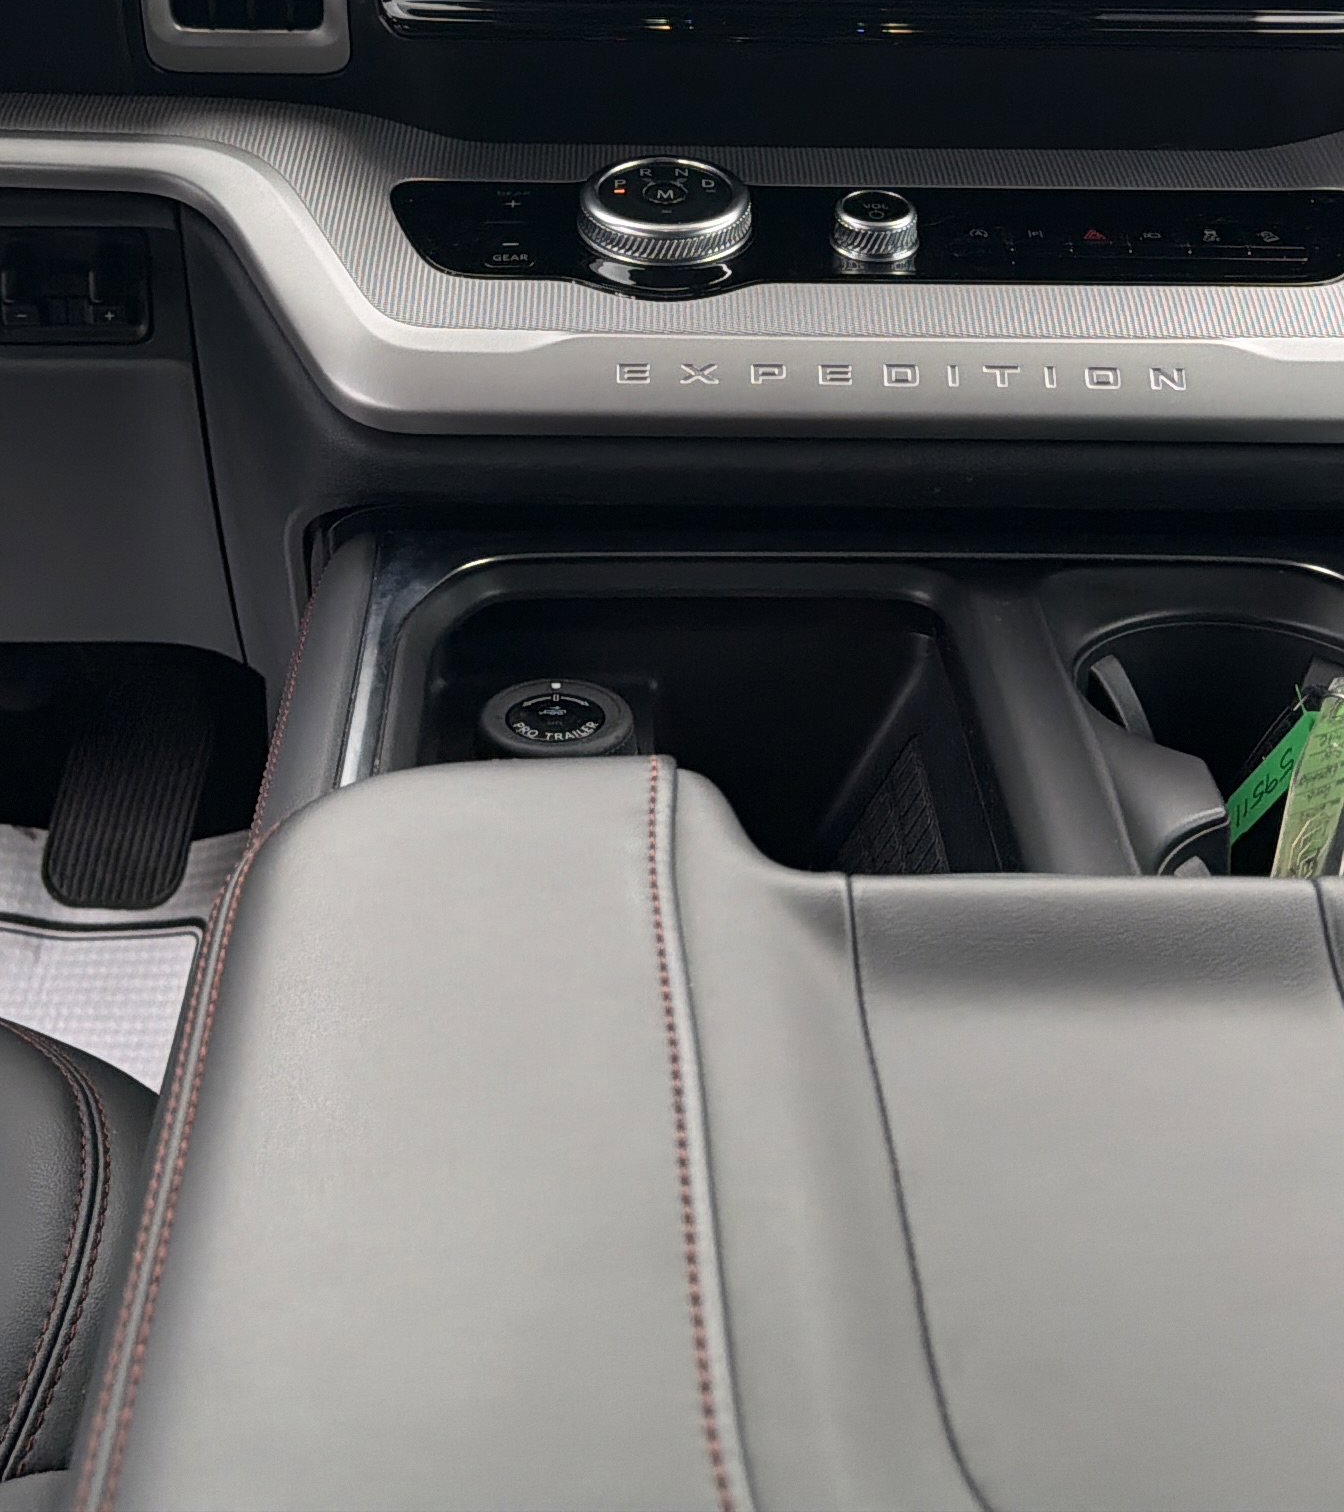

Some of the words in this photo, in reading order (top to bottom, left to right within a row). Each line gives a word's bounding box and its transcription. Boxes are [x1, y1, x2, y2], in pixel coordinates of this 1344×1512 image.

[639, 168, 653, 178] R
[674, 167, 690, 178] N
[613, 179, 627, 189] P
[700, 178, 716, 189] D
[656, 188, 676, 200] M
[491, 253, 529, 263] GEAR
[616, 362, 1187, 391] EXPEDITION
[512, 721, 539, 740] PRO
[544, 721, 600, 741] TRAILER
